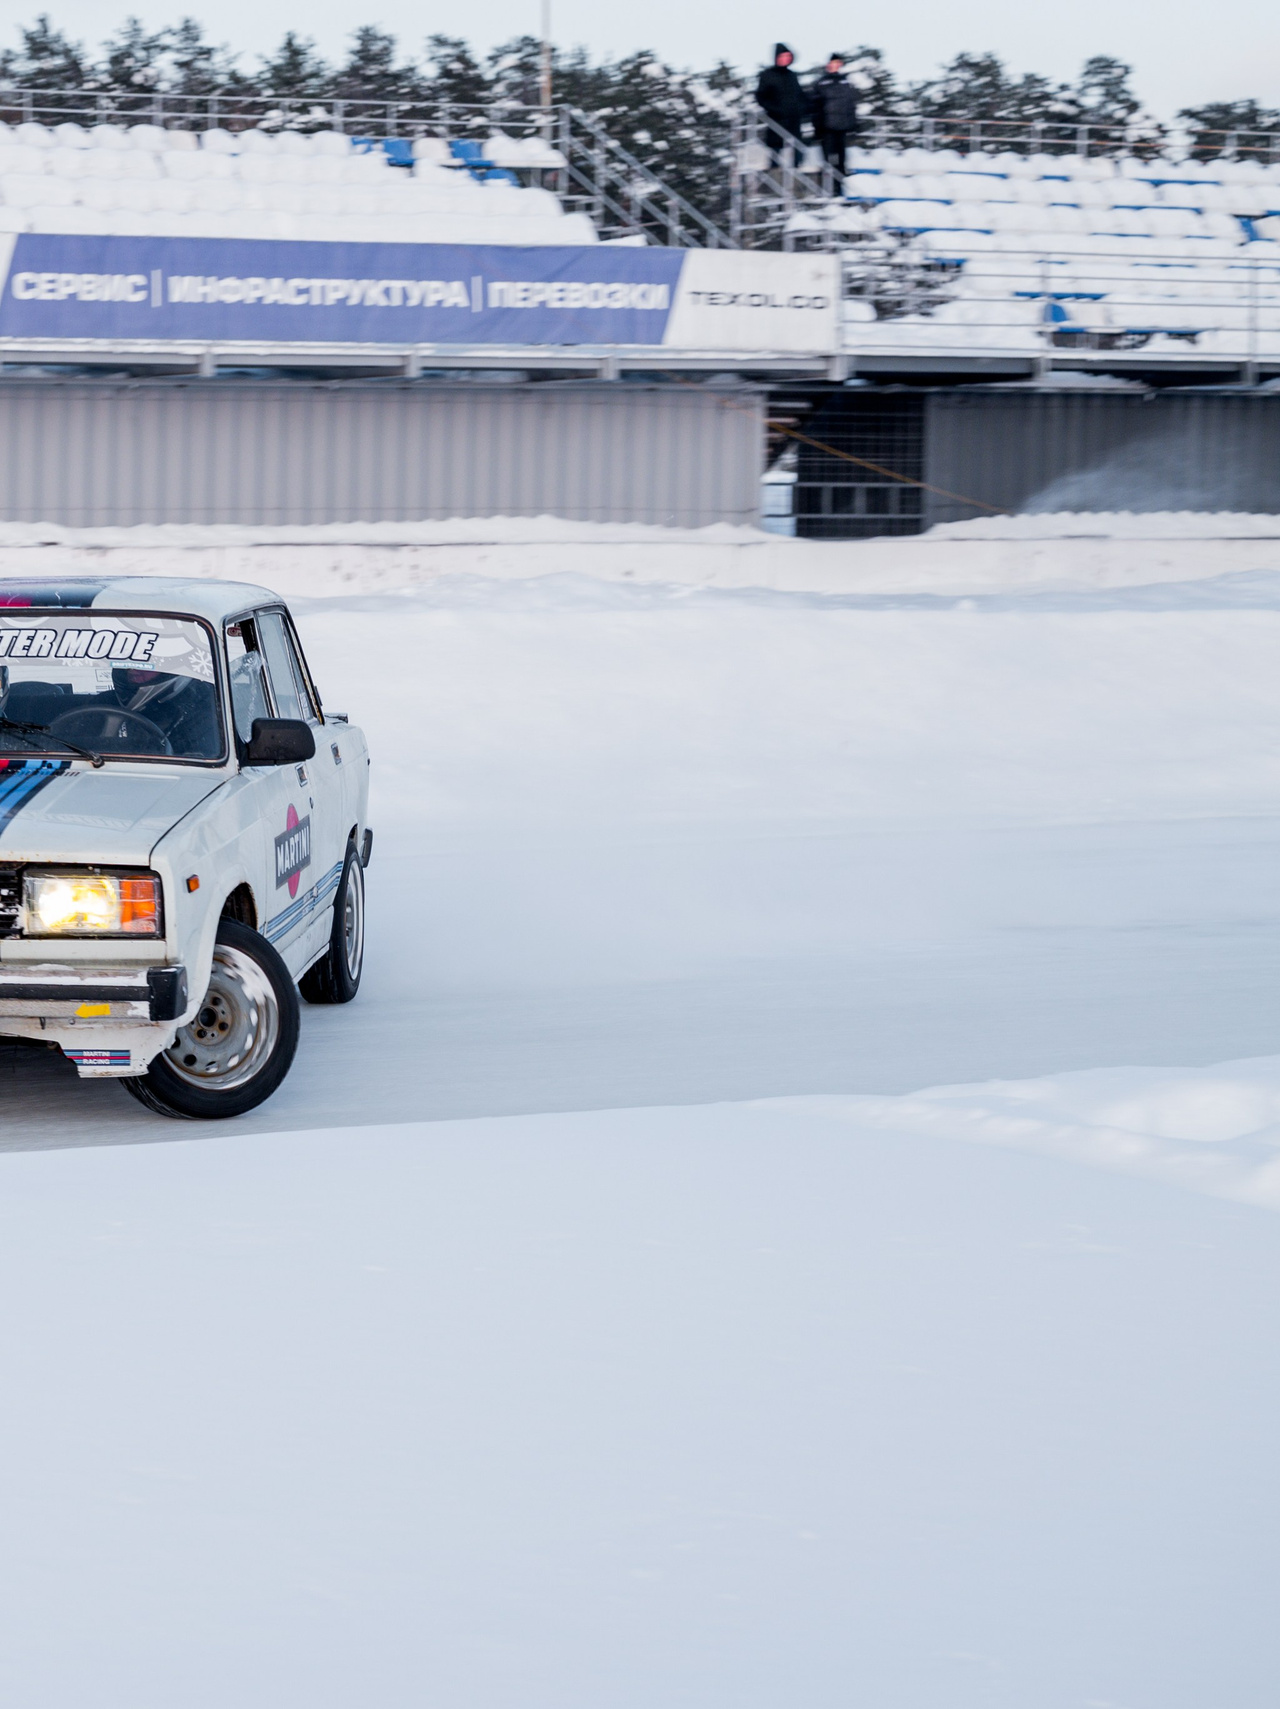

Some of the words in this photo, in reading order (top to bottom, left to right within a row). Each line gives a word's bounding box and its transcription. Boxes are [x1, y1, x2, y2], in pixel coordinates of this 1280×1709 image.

[11, 272, 149, 302] СЕРВИС
[167, 275, 470, 308] ИНФРАСТРУКТУРА
[487, 281, 670, 310] ПЕРЕВОЗКИ
[54, 629, 159, 662] MODE
[276, 826, 310, 877] MARTINI
